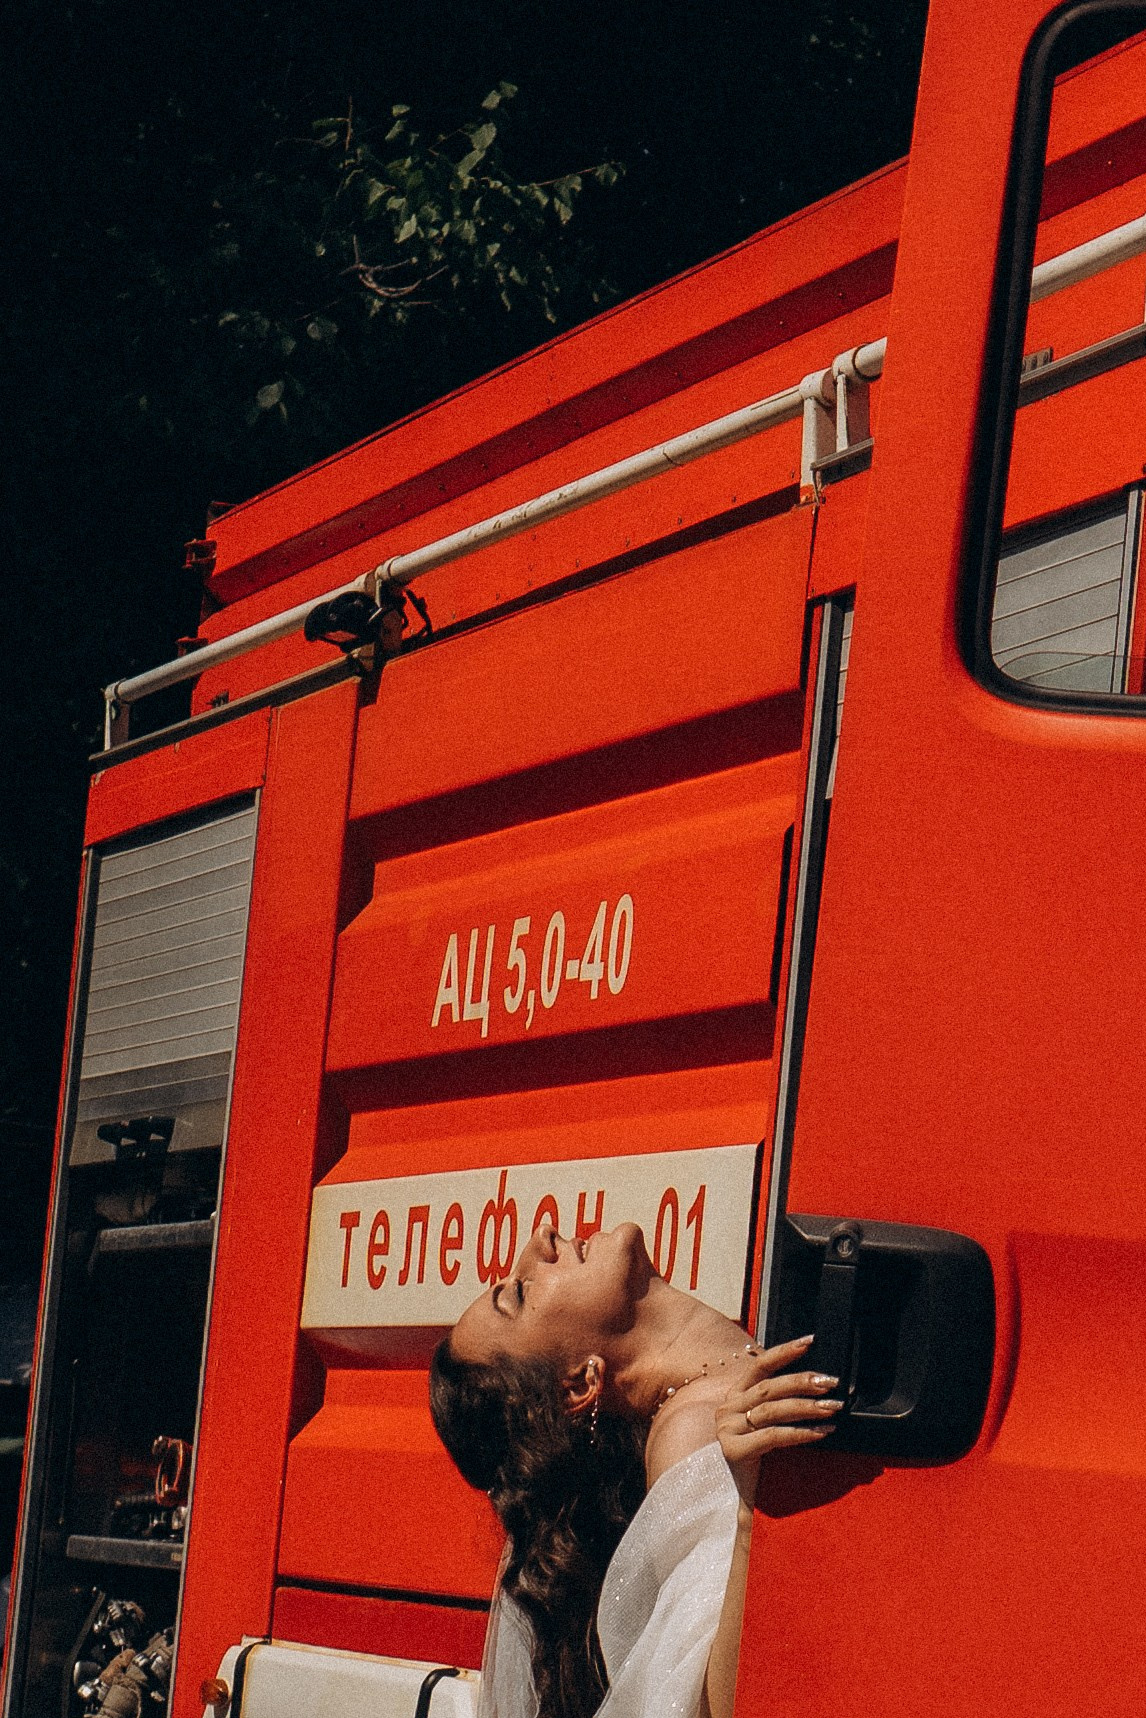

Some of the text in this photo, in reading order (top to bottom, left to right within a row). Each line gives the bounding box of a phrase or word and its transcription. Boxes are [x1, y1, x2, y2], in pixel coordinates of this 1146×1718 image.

[431, 893, 634, 1038] АЦ 5,0-40
[653, 1184, 707, 1291] 01
